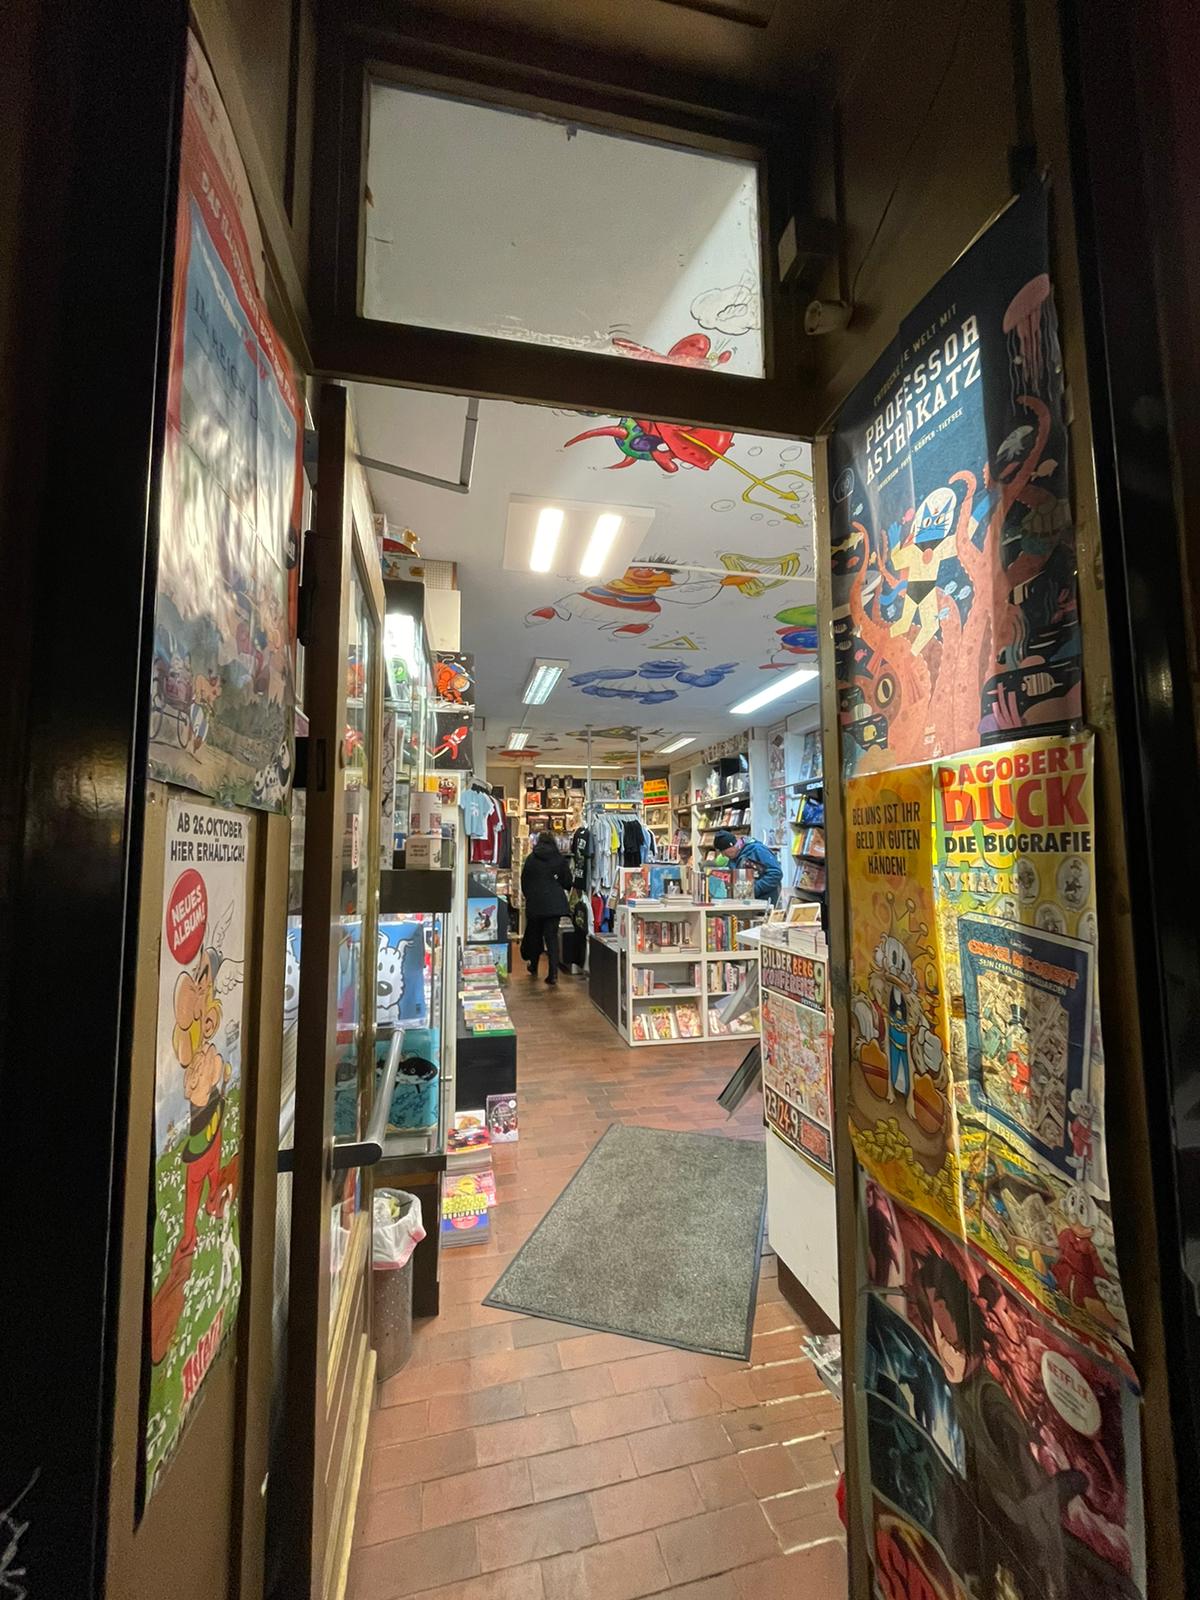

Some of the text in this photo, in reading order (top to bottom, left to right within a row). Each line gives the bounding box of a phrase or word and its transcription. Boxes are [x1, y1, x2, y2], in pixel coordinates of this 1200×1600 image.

[911, 321, 938, 353] WELT
[865, 314, 980, 454] PROFESSOR
[865, 346, 982, 485] ASTROKATZ
[938, 743, 1088, 789] DAGOBERT
[852, 800, 921, 826] BEI UNS IST IHR
[942, 772, 1091, 833] DUCK
[176, 811, 243, 839] AB 26.OKTOBER
[855, 827, 921, 851] GELD IN GUTEN
[944, 831, 1092, 854] DIE BIOGRAFIE
[867, 852, 907, 876] HÄNDEN!
[171, 884, 202, 926] NEUES
[172, 901, 206, 952] ALBUM!
[762, 945, 792, 974] BILDER
[792, 956, 814, 978] BERG
